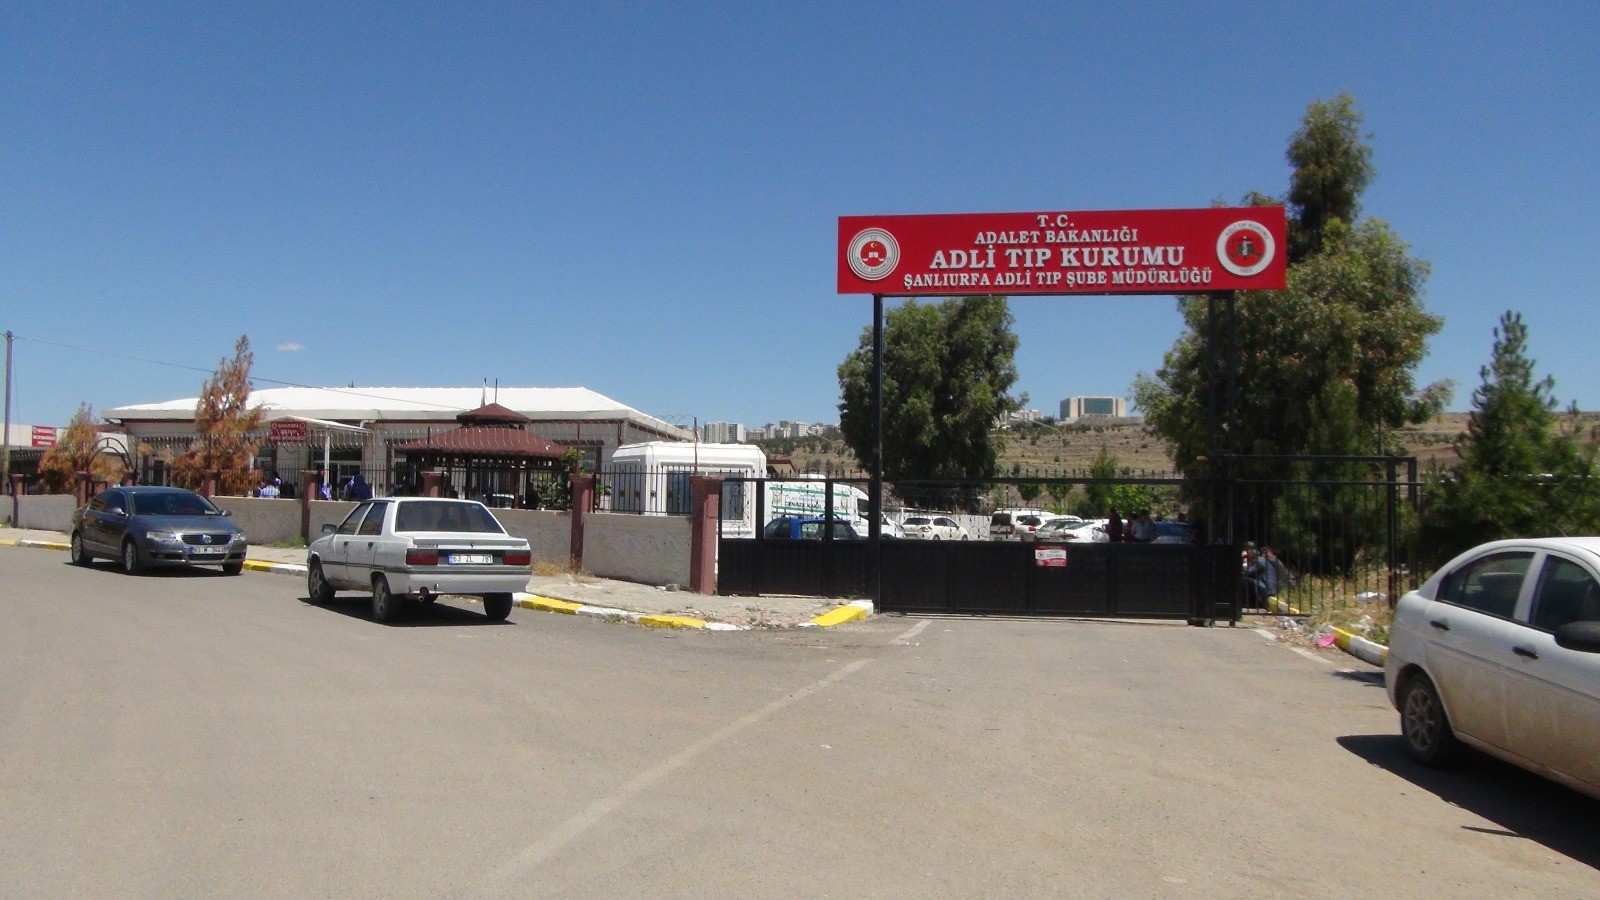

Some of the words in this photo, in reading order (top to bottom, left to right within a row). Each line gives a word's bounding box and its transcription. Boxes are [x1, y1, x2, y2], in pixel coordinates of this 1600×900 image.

[1037, 214, 1074, 227] T.C.
[974, 231, 1041, 244] ADALET
[1045, 226, 1138, 243] BAKANLIĞI
[929, 244, 996, 269] ADLİ
[1005, 248, 1052, 268] TIP
[1060, 246, 1185, 267] KURUMU
[904, 273, 991, 290] ŞANLIURFA
[994, 270, 1032, 286] ADLİ
[1036, 271, 1062, 285] TIP
[1066, 271, 1107, 288] ŞUBE
[1111, 267, 1212, 284] MÜDÜRLÜĞÜ
[466, 554, 474, 563] ZL
